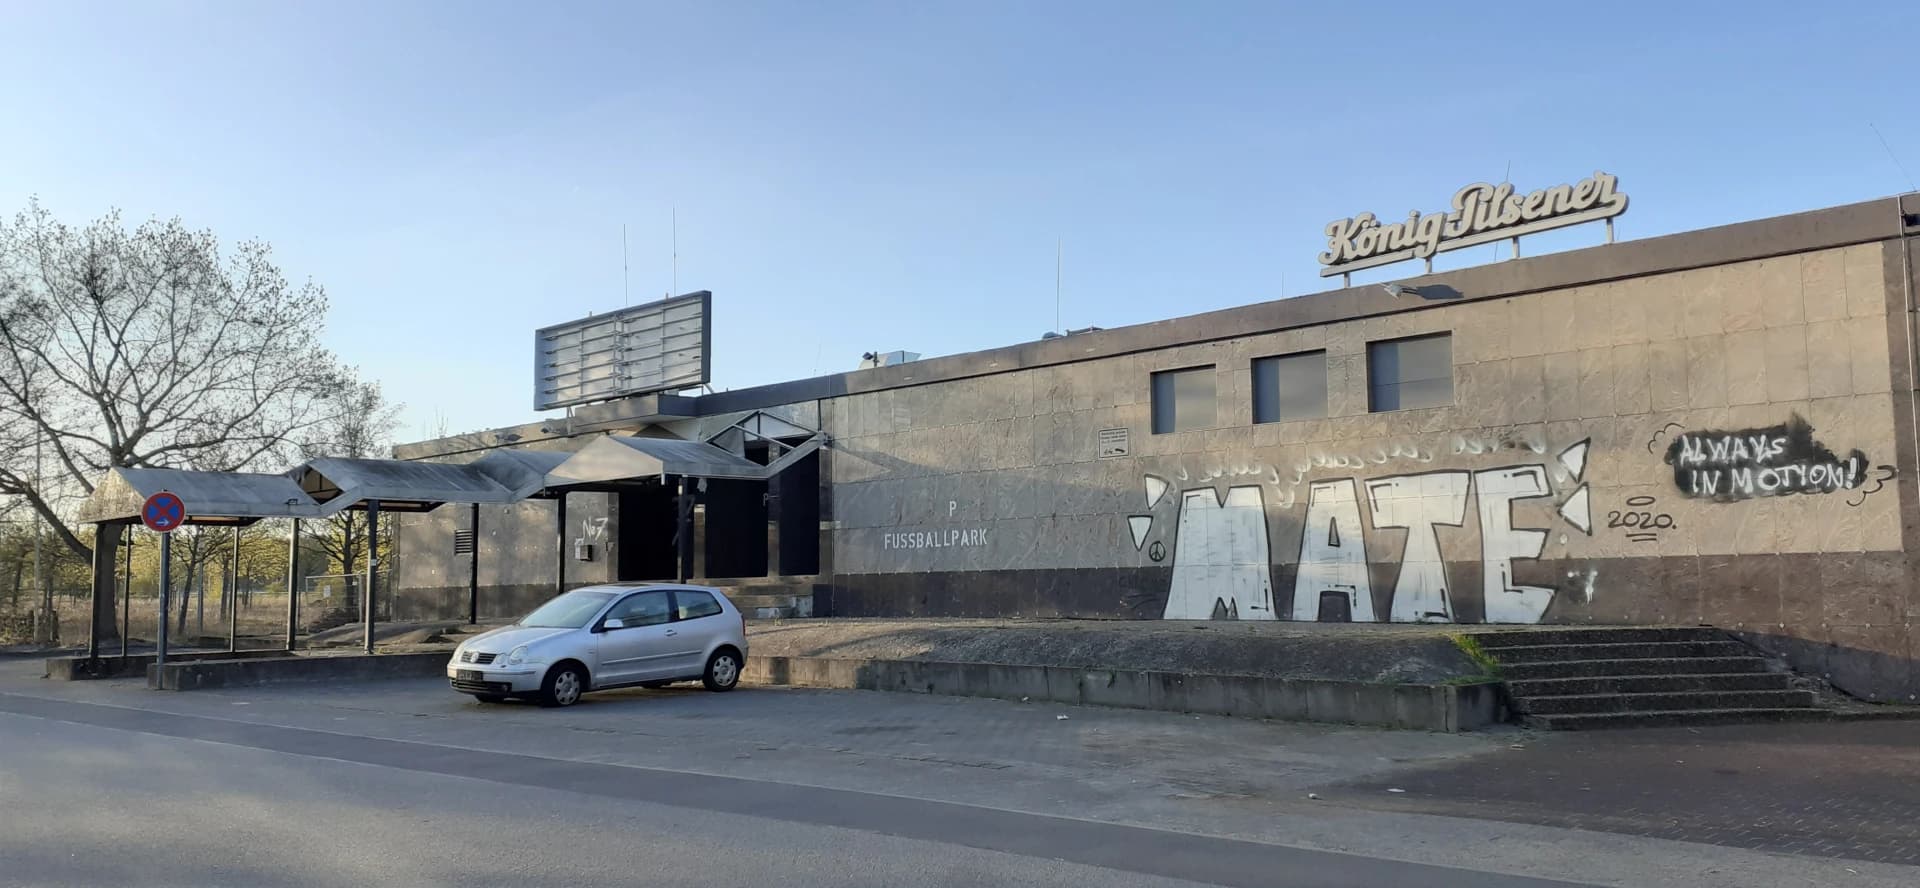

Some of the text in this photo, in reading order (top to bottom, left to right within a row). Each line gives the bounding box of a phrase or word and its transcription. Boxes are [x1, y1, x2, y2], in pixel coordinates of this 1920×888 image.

[1680, 435, 1787, 466] ALWAYS
[1692, 469, 1721, 495] IN
[949, 500, 957, 517] P
[884, 528, 988, 550] FUSSBALLPARK
[1163, 463, 1558, 624] MATE
